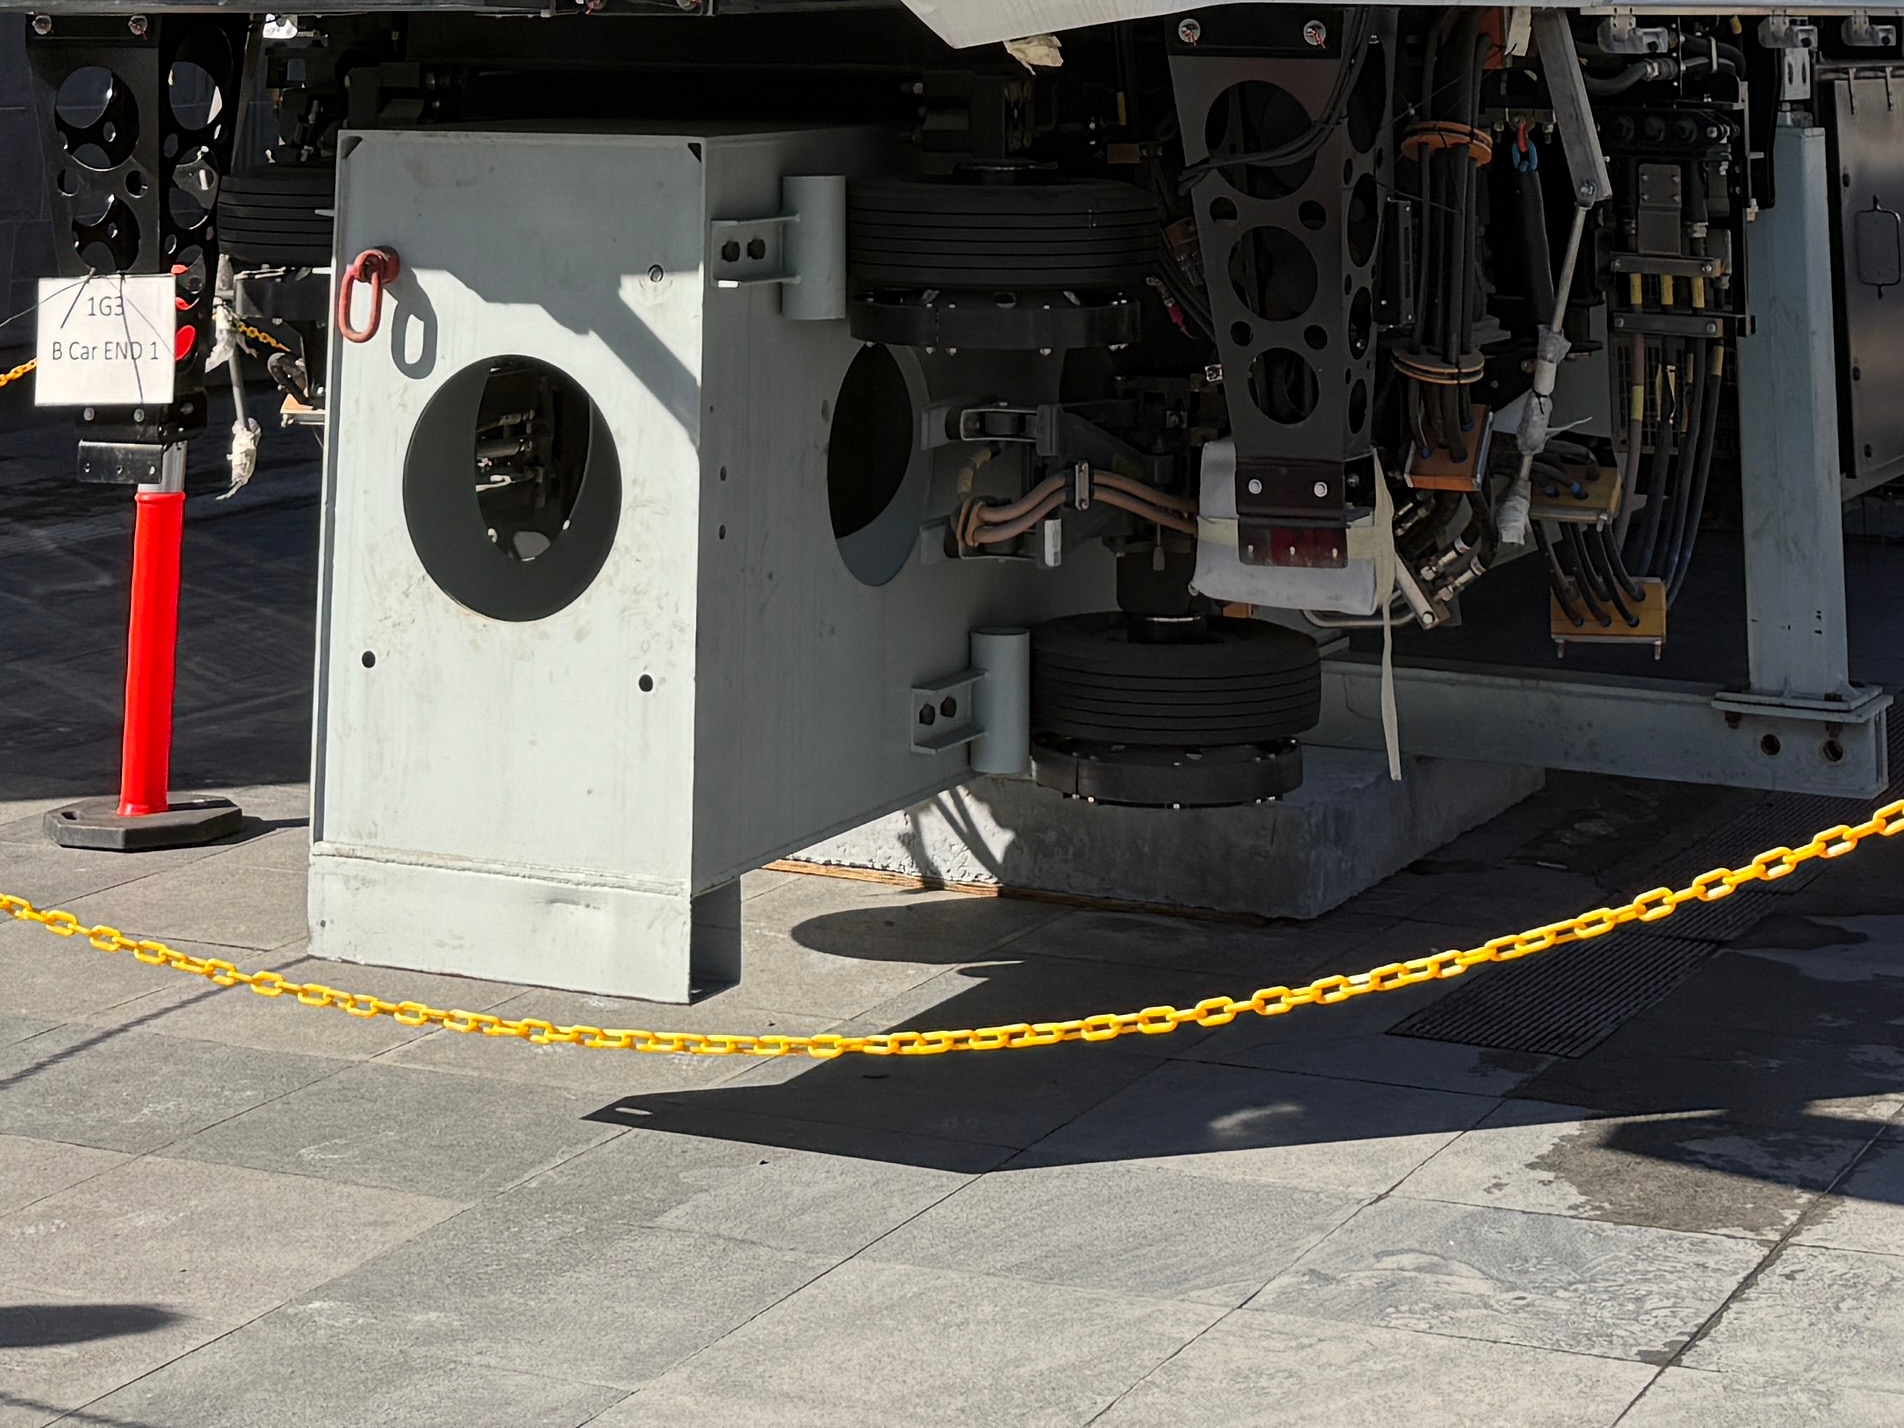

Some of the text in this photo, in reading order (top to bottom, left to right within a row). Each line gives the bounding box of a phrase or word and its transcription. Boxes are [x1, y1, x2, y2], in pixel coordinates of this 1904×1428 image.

[87, 296, 125, 317] 1G3
[52, 341, 160, 361] B Car END 1
